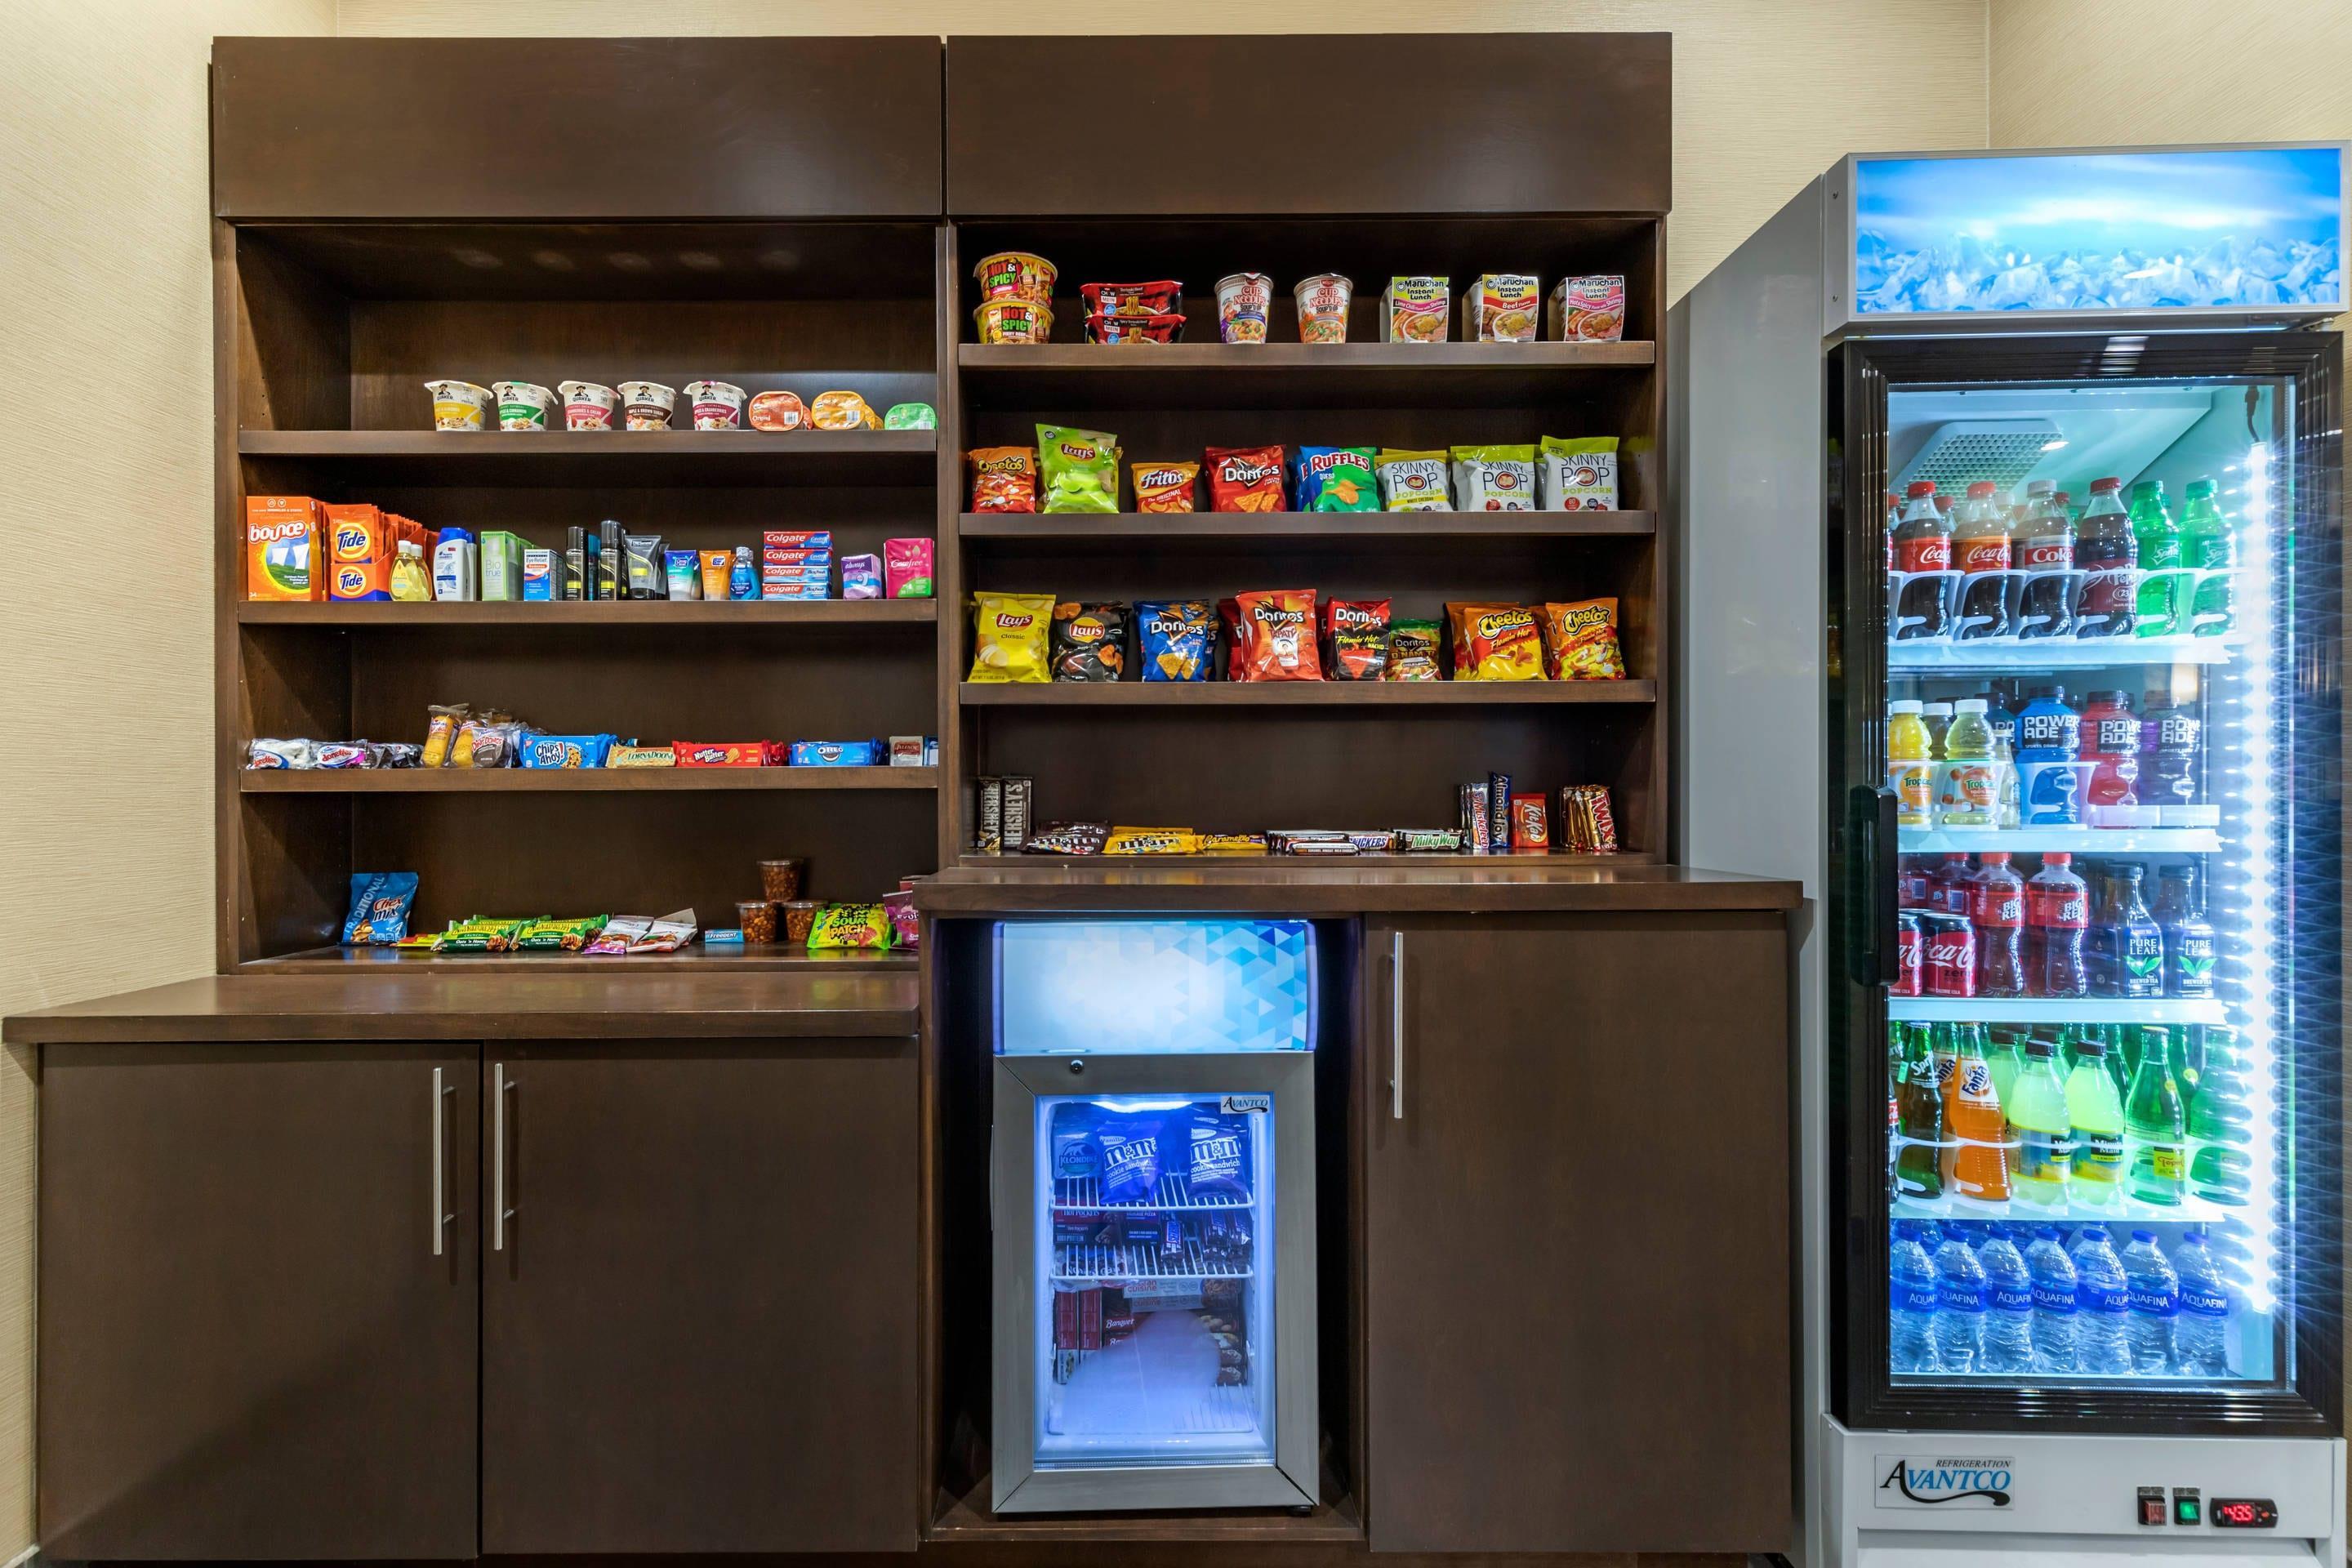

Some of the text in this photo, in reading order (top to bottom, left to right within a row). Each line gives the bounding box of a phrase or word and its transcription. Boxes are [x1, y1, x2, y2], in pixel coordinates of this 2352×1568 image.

[988, 262, 1007, 275] HOT
[989, 273, 1016, 287] SPICY
[1405, 279, 1444, 287] Maruchan
[1241, 287, 1262, 296] CUP
[1317, 288, 1339, 296] CUP
[1233, 295, 1266, 306] NOODLES
[1310, 296, 1343, 308] NOODLES
[1002, 308, 1026, 319] HOT
[1002, 319, 1032, 331] SPICY
[1063, 444, 1094, 458] Lay's
[978, 457, 1025, 474] Cheetos
[1311, 452, 1370, 474] RUFFLES
[1482, 461, 1523, 472] SKINNY
[1561, 455, 1606, 466] SKINNY
[1225, 465, 1281, 481] Doritos
[1392, 462, 1436, 474] SKINNY
[1142, 471, 1183, 488] Fritos
[1393, 473, 1438, 491] POP
[1483, 472, 1528, 490] POP
[1561, 466, 1610, 486] POP
[1156, 490, 1182, 501] ORIGINAL
[1396, 488, 1442, 498] POPCORN
[250, 523, 305, 541] bounce
[766, 534, 806, 543] Colgate
[337, 531, 366, 552] Tide
[766, 551, 804, 560] Colgate
[2032, 547, 2073, 562] Coke
[340, 573, 363, 590] Tide
[998, 614, 1032, 627] Lay's
[1254, 608, 1304, 622] Doritos
[1335, 608, 1382, 626] Doritos
[1563, 607, 1609, 634] Cheetos
[1151, 621, 1204, 635] Doritos
[1480, 611, 1533, 637] Cheetos
[1517, 629, 1531, 639] Hot
[2025, 716, 2080, 727] POWER
[2025, 728, 2058, 739] ADE
[2100, 733, 2135, 743] ADE
[2161, 732, 2195, 743] ADE
[536, 744, 559, 758] Chips
[694, 749, 715, 761] Nutter
[705, 751, 725, 762] Butter
[817, 746, 844, 755] OREO
[1494, 776, 1508, 820] Almond
[984, 781, 1000, 840] HERSHEY'S
[1004, 783, 1022, 846] HERSHEY'S
[1592, 791, 1616, 840] TWIX
[1411, 834, 1460, 849] Milky Way
[344, 876, 385, 933] TRADITIONAL
[373, 898, 403, 911] Chex
[2003, 898, 2020, 911] BIG
[2065, 899, 2083, 911] BIG
[2063, 909, 2084, 921] RED
[832, 917, 866, 927] SOUR
[831, 924, 866, 937] PATCH
[2130, 938, 2157, 947] PURE
[2185, 947, 2212, 956] LE
[1939, 1058, 1955, 1082] anta
[1962, 1065, 1988, 1095] Fanta
[1223, 1097, 1268, 1111] AVANTCO
[1060, 1155, 1098, 1164] KLONDIKE
[1107, 1167, 1125, 1179] cookie
[1909, 1294, 1937, 1305] AQUAF
[1997, 1291, 2031, 1304] AQUAFIN
[2031, 1287, 2075, 1305] AQUAFINA
[1105, 1318, 1135, 1329] Banquet
[1936, 1459, 2011, 1468] REFRIGERATION
[1880, 1459, 2011, 1497] AVANTCO
